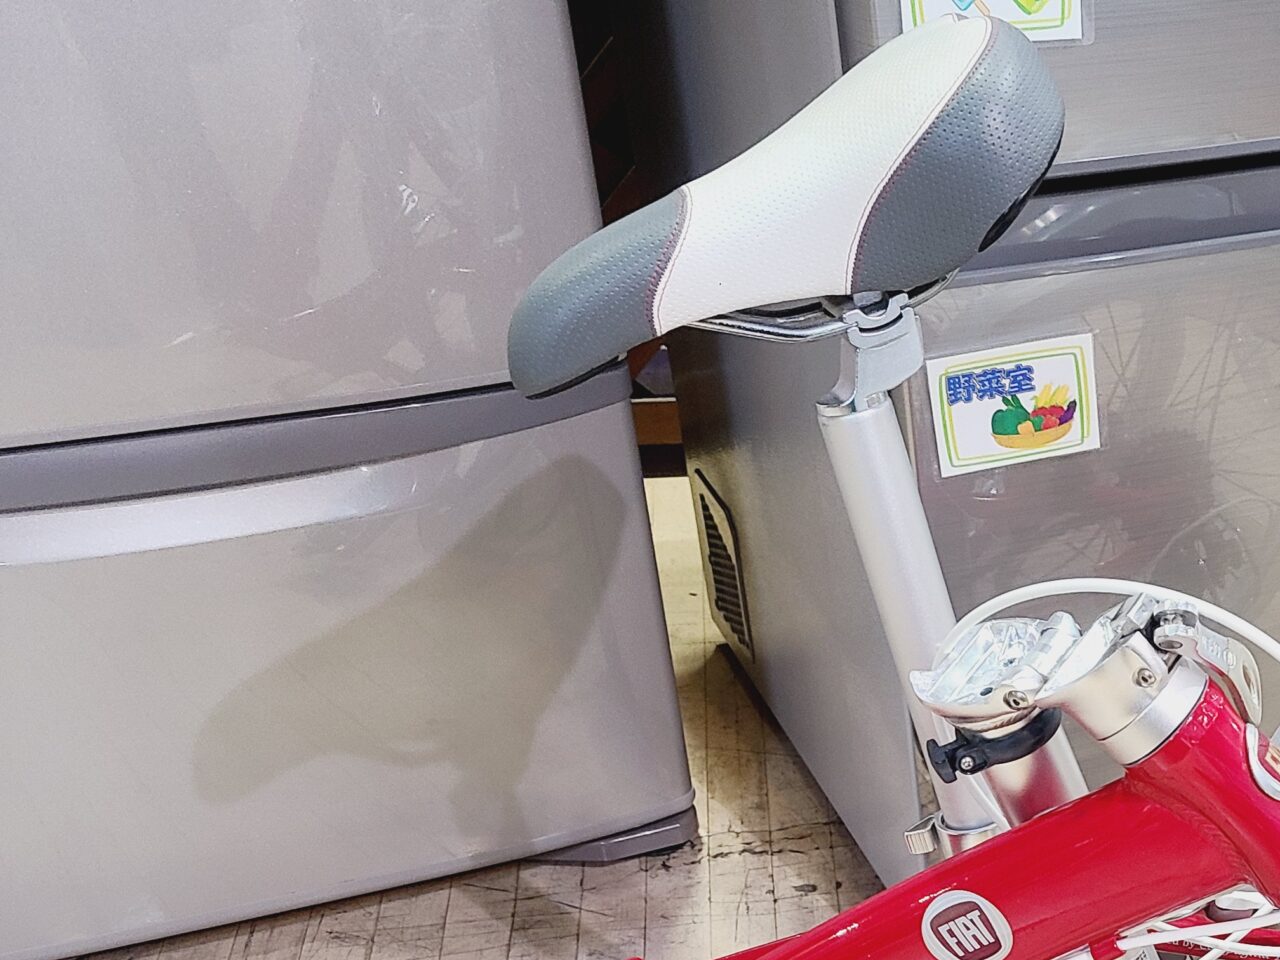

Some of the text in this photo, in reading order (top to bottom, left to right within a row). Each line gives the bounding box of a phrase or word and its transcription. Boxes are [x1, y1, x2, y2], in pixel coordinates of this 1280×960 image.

[945, 363, 1036, 406] 野菜室
[937, 908, 996, 957] FIAT
